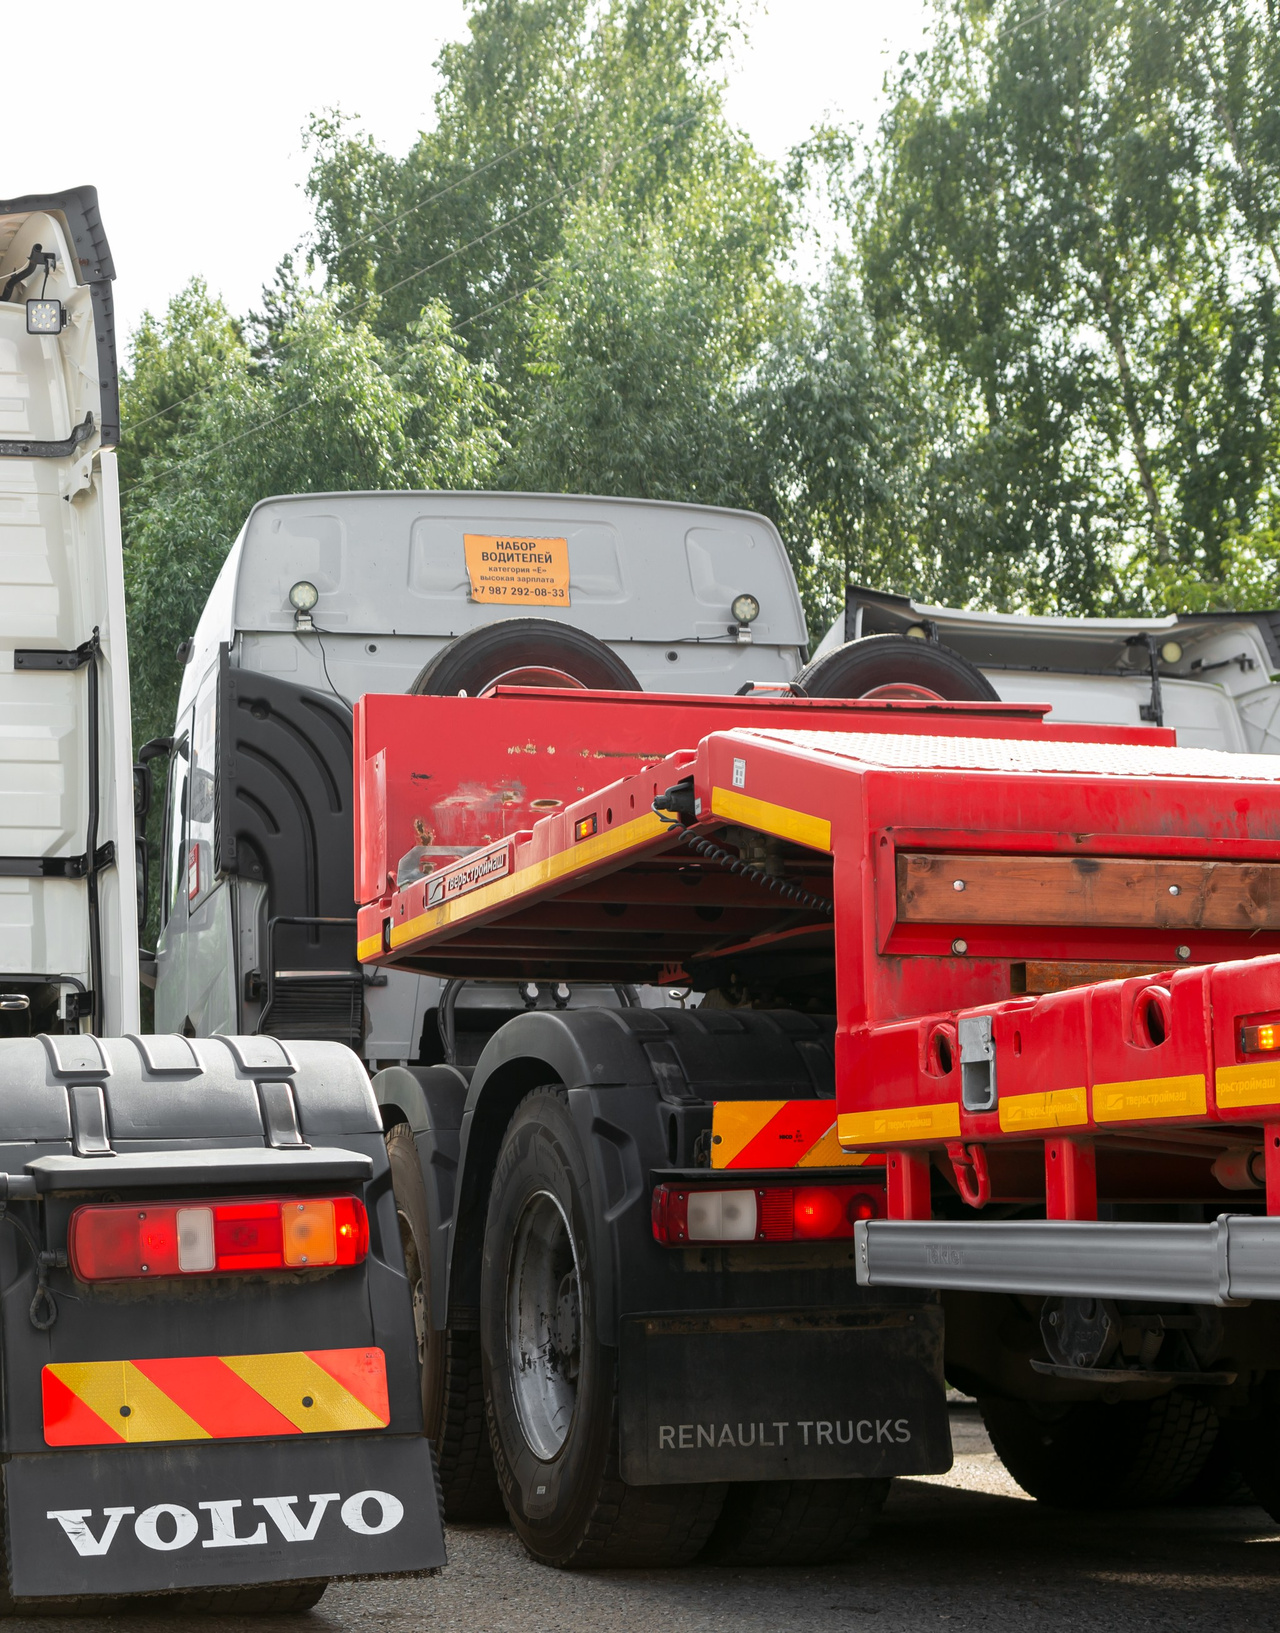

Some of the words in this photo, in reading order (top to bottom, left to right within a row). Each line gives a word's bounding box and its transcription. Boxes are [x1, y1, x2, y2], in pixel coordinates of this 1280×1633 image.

[496, 541, 536, 551] НАБОР
[481, 552, 552, 563] ВОДИТЕЛЕЙ
[488, 566, 530, 574] категория
[517, 576, 555, 584] зарплата
[474, 586, 485, 594] +7
[488, 586, 507, 595] 987
[511, 587, 565, 598] 292-08-33
[659, 1421, 789, 1449] RENAULT
[797, 1419, 912, 1446] TRUCKS
[46, 1490, 404, 1557] VOLVO
